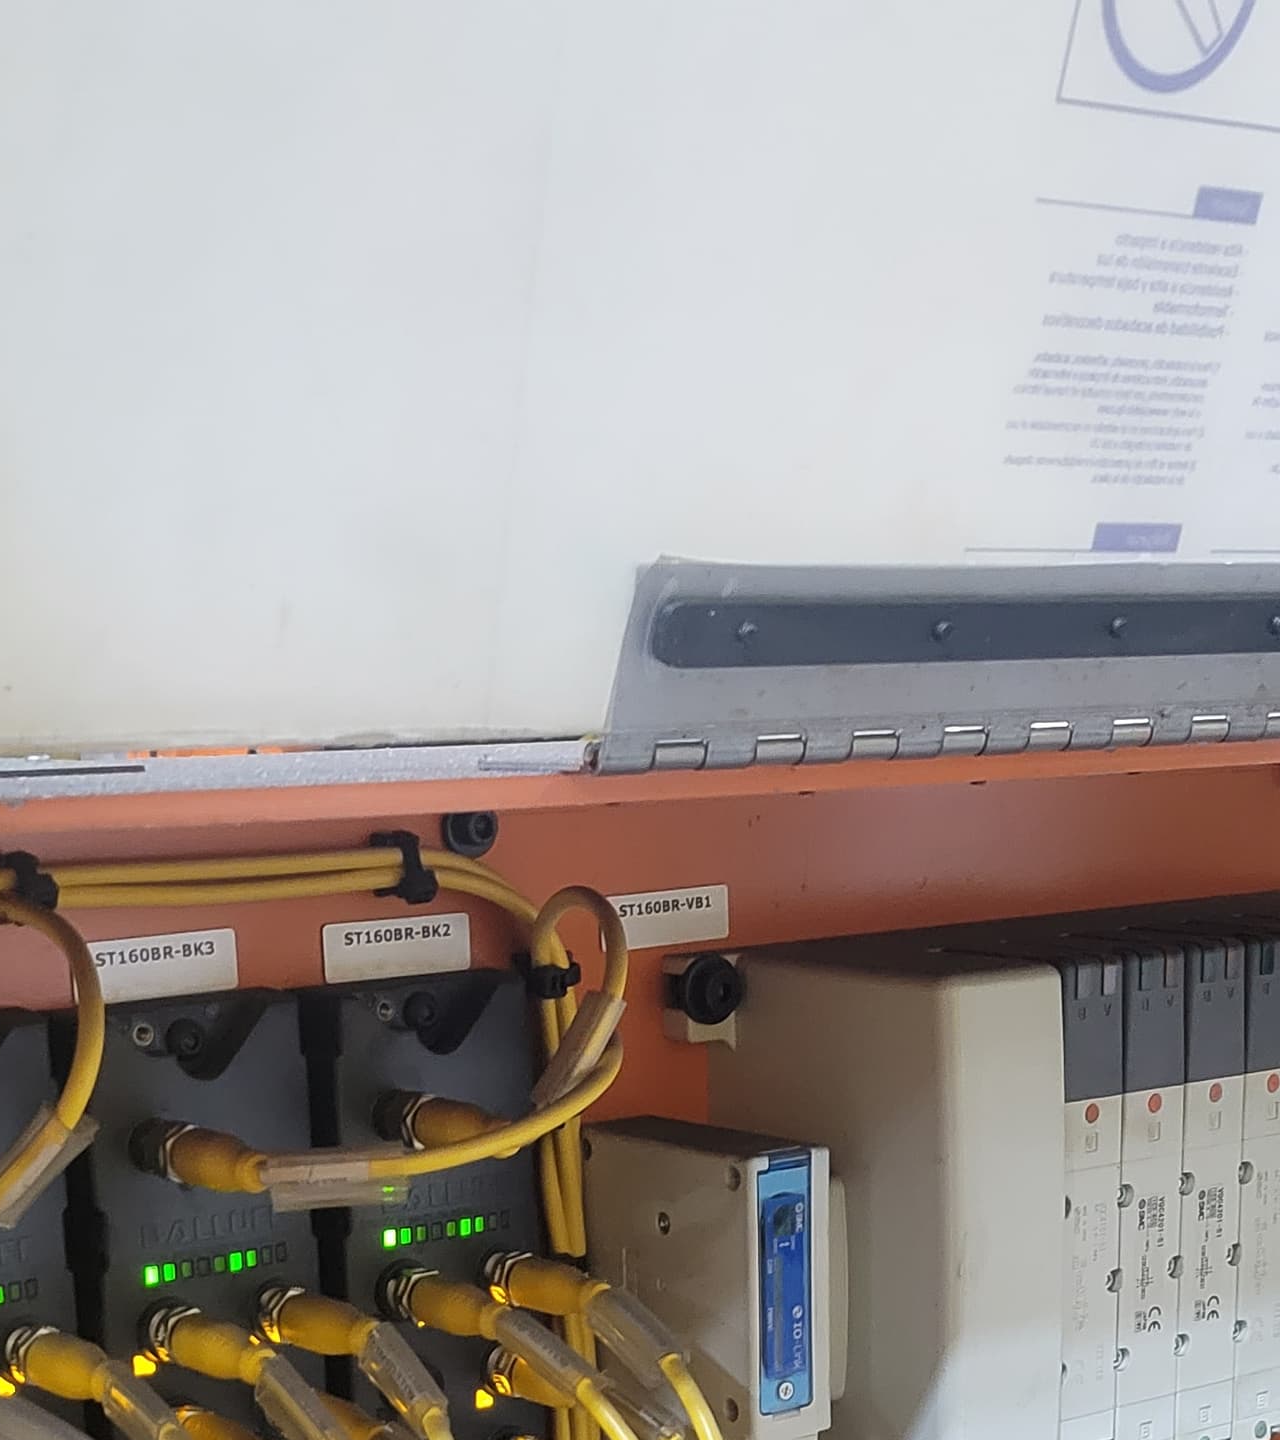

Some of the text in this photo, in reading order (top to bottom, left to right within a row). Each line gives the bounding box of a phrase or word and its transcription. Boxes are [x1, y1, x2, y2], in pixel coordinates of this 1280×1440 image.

[618, 895, 712, 919] ST160BR-VB1
[343, 922, 451, 948] ST160BR-BK2
[95, 940, 216, 969] ST160BR-BK3
